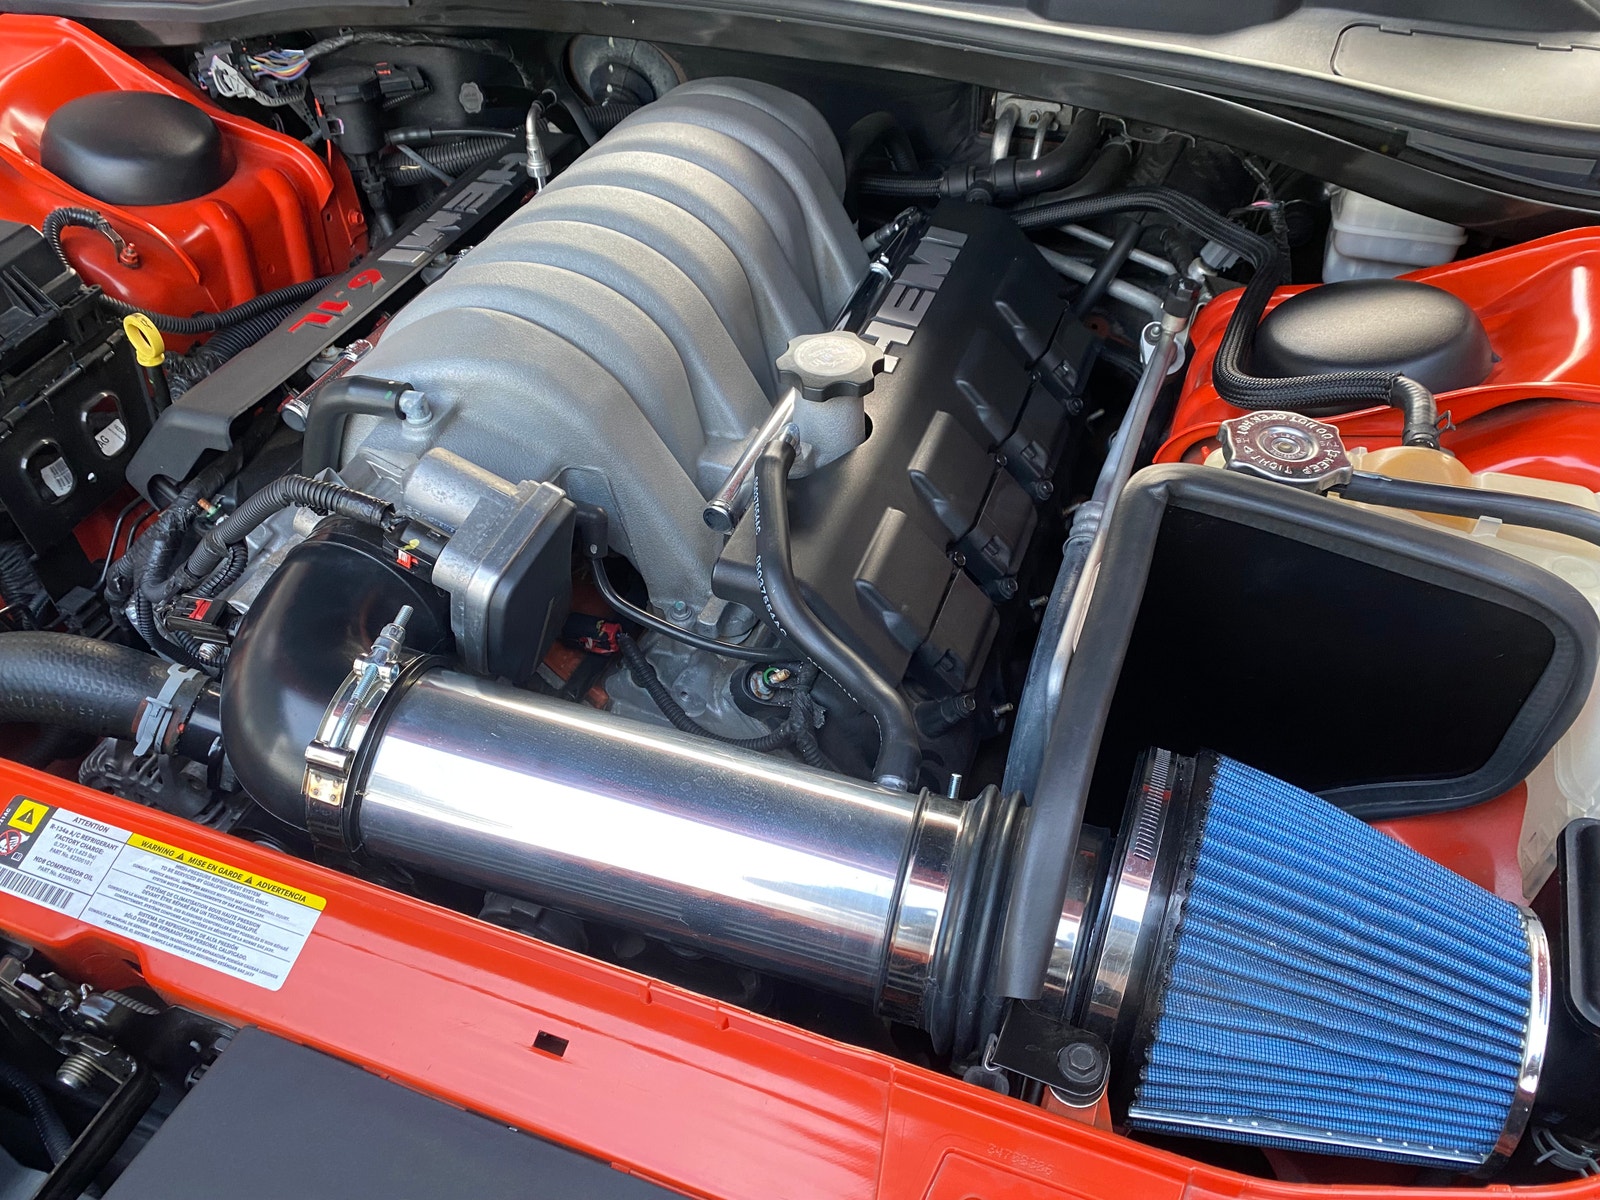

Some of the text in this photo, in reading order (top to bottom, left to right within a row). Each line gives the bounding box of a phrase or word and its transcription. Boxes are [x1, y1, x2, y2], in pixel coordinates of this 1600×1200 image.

[288, 152, 530, 333] HEMI 6.1L
[865, 226, 967, 373] HEMI
[50, 824, 69, 833] R-134a
[81, 835, 117, 850] REFRIGERANT
[73, 817, 109, 832] ATTENTION
[55, 834, 104, 854] FACTORY CHARGE:
[46, 861, 83, 876] COMPRESSOR
[141, 841, 174, 856] WARNING
[188, 857, 206, 867] MISE
[218, 868, 242, 879] GARDE
[256, 881, 306, 901] ADVERTENCIA
